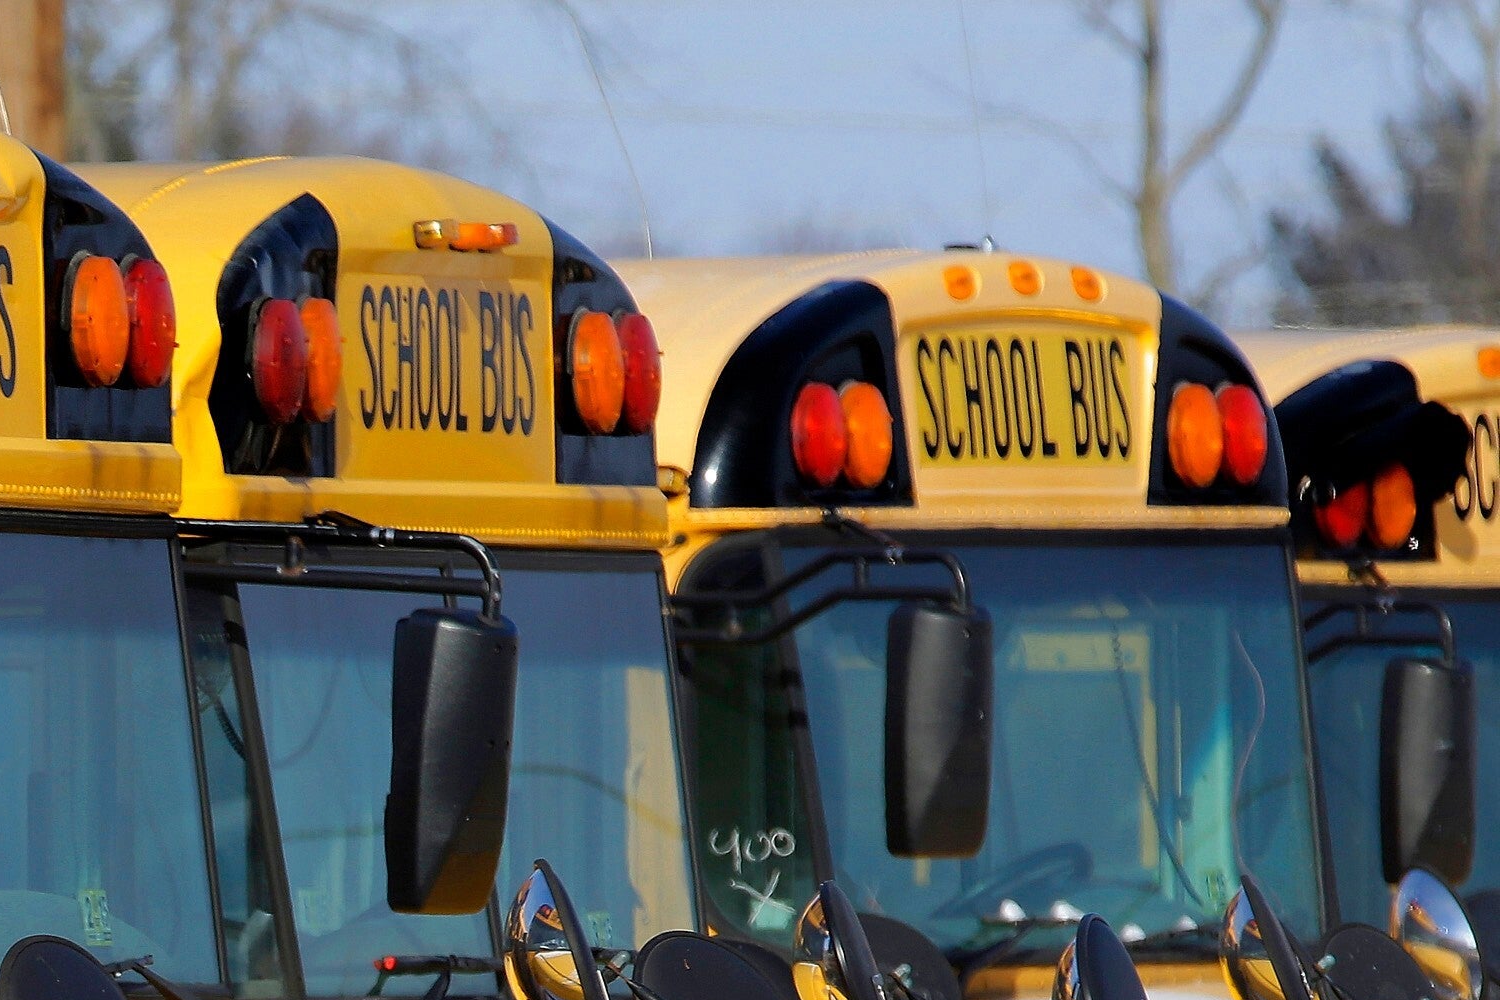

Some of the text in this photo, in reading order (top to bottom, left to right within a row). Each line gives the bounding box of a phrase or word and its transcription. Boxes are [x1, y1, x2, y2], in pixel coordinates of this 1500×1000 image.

[359, 285, 536, 437] SCHOOL BUS
[916, 337, 1132, 460] SCHOOL BUS
